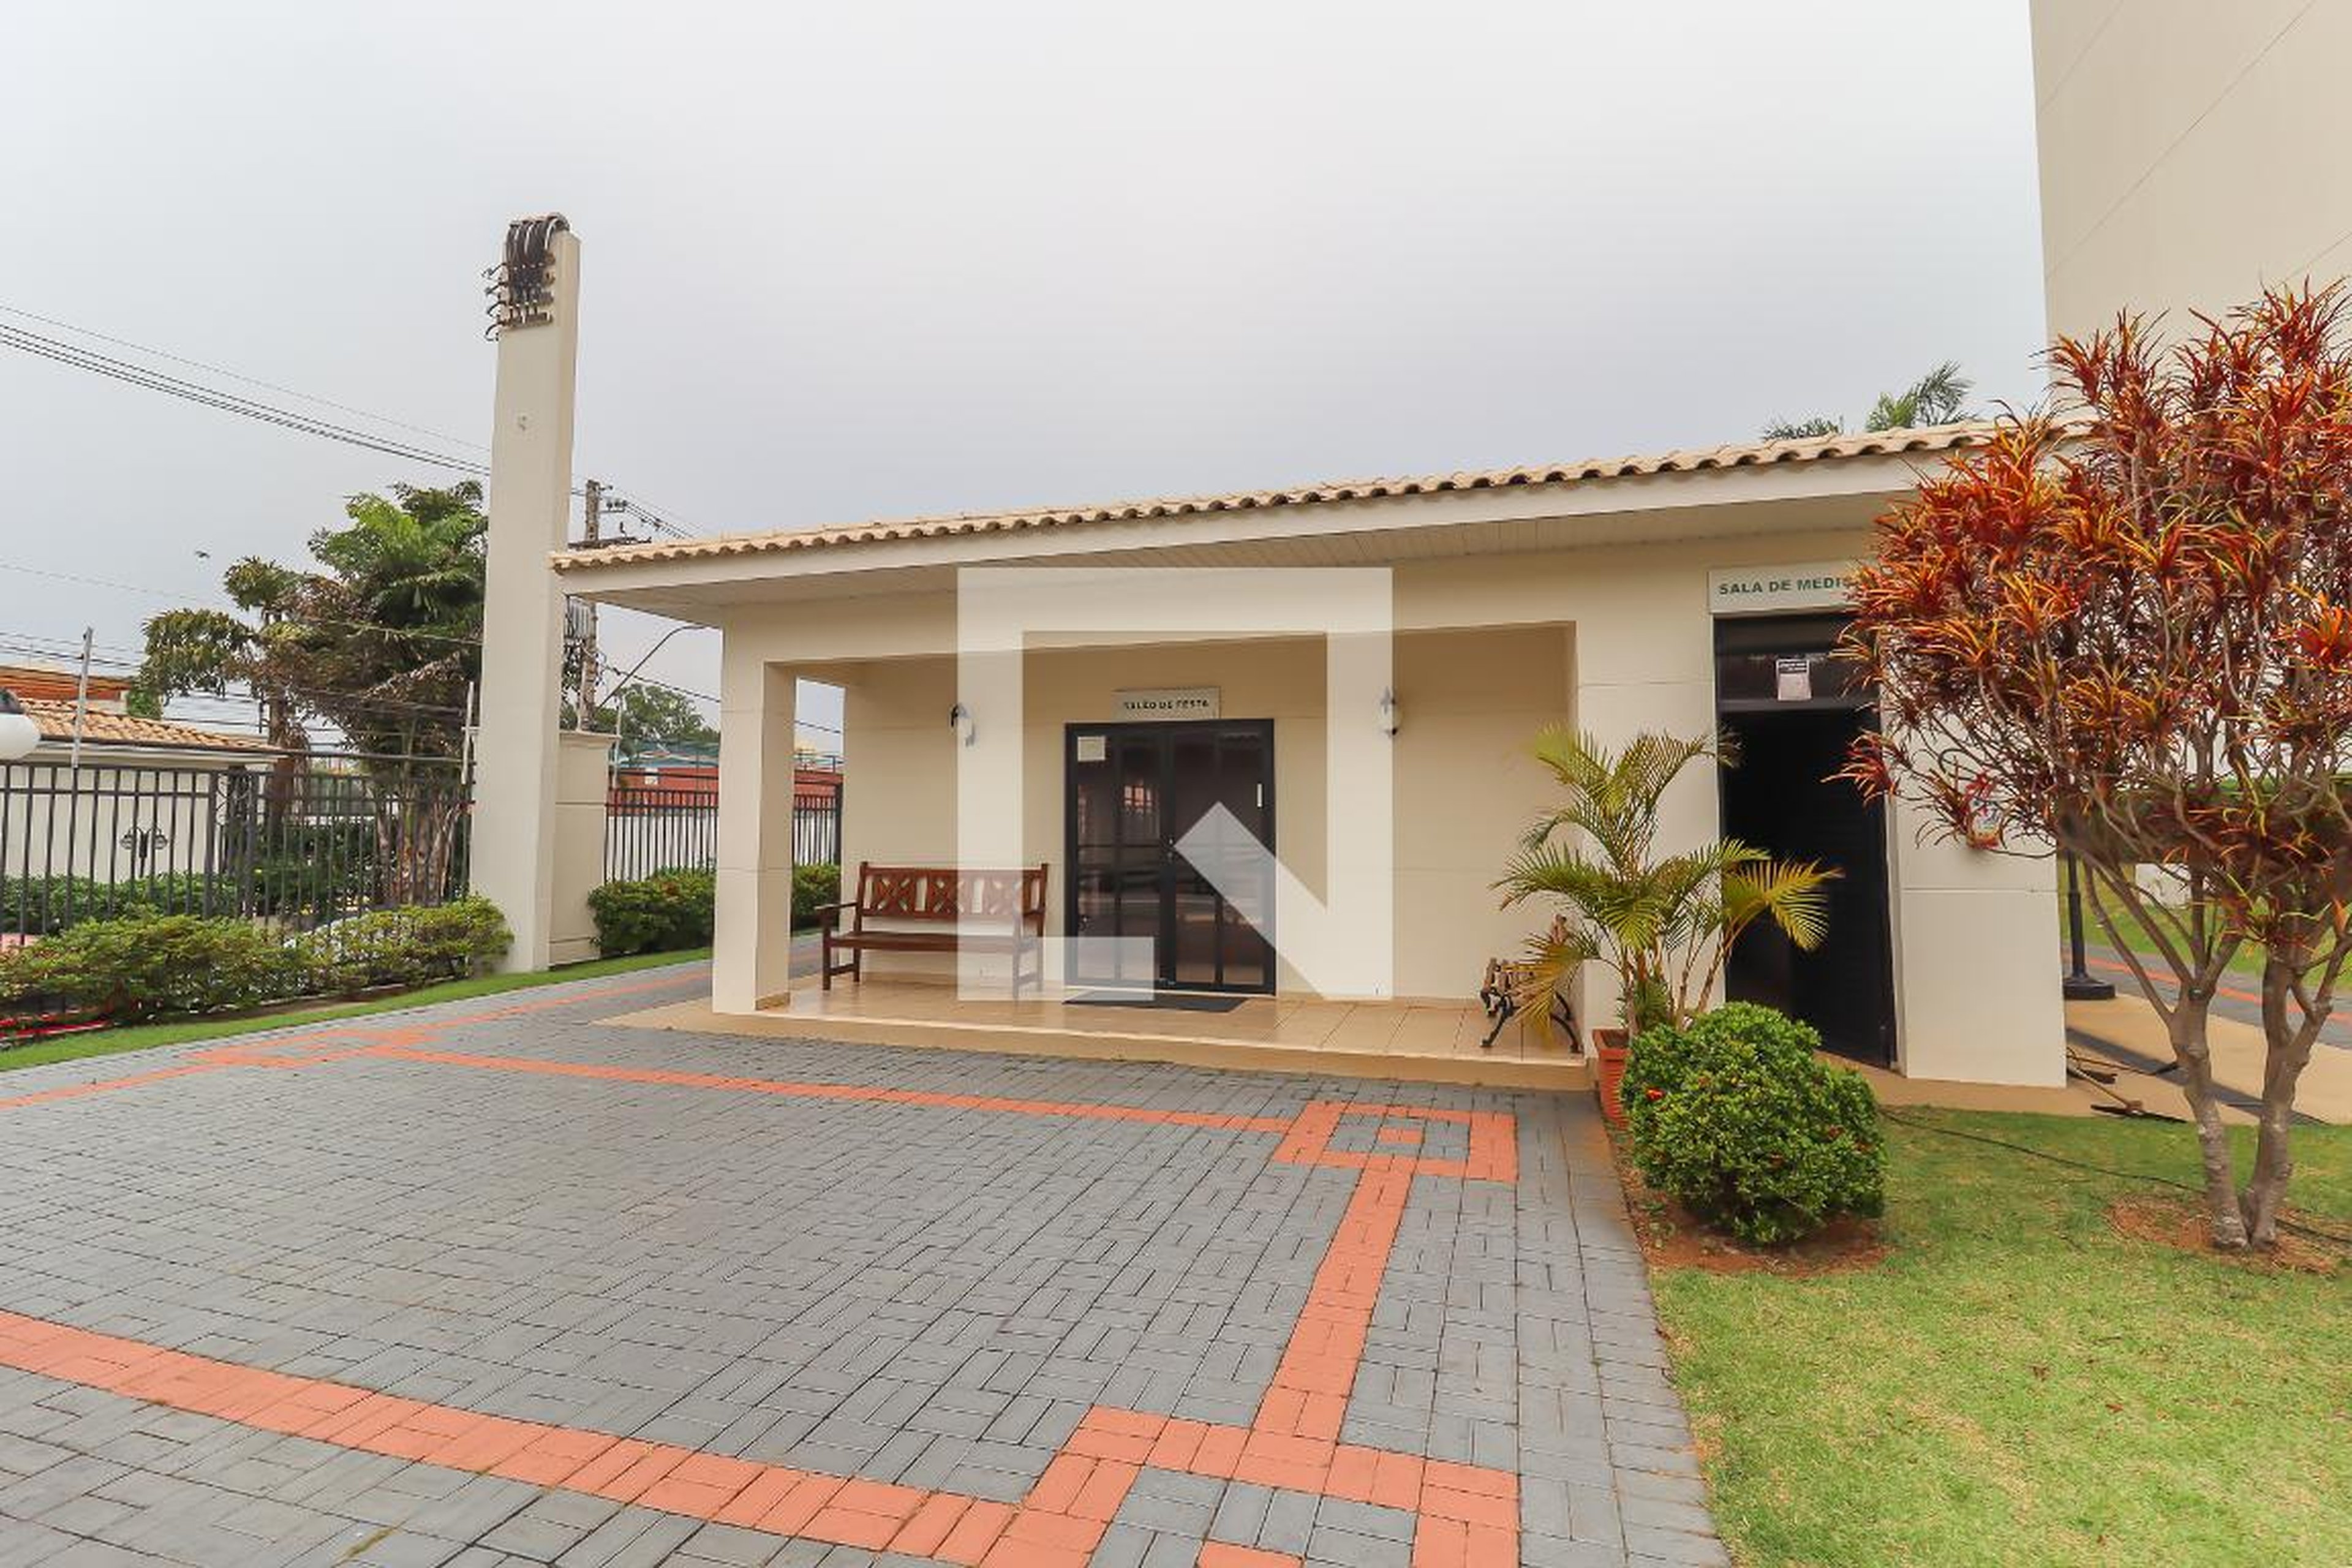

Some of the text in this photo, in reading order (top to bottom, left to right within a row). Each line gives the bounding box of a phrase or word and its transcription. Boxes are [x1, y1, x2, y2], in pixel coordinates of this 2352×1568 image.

[1719, 577, 1842, 595] SALA DE MEDI
[1159, 700, 1173, 709] DE
